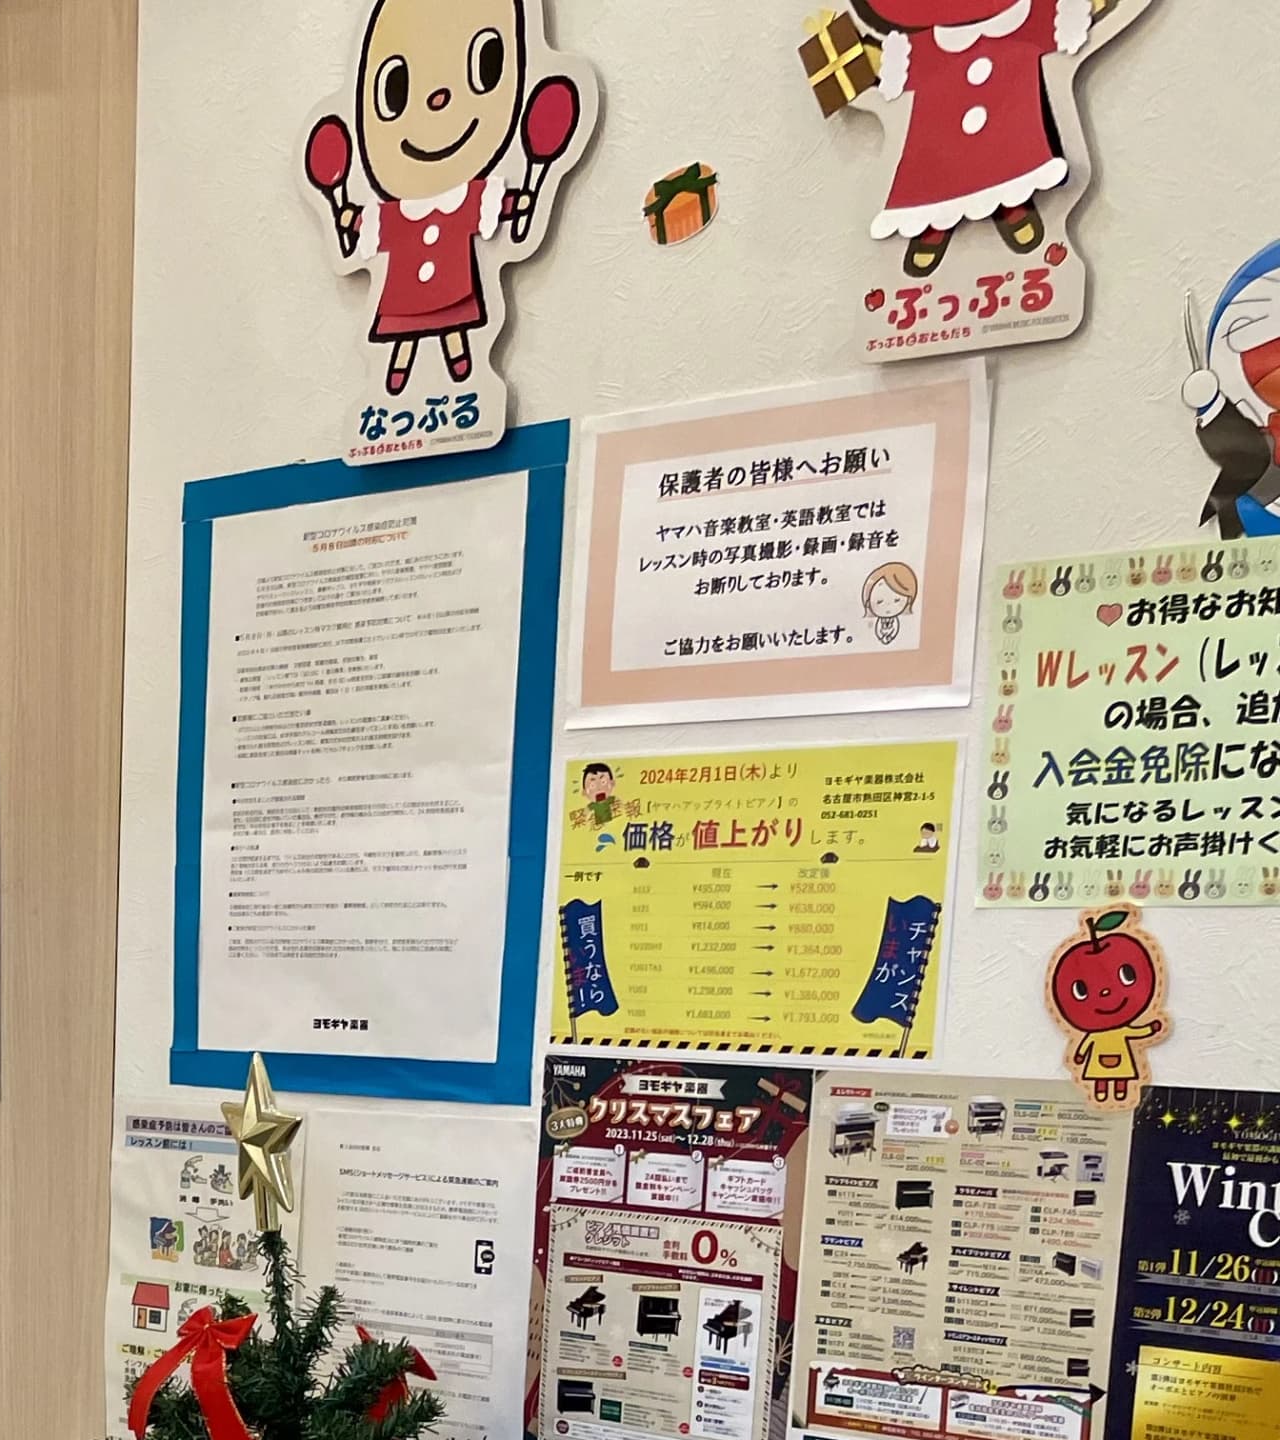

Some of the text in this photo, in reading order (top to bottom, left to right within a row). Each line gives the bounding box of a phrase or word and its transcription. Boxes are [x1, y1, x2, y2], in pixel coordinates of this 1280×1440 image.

[888, 267, 1054, 331] ぷっぷる
[658, 446, 891, 498] 保護者の皆様へお願い
[655, 499, 887, 542] ヤマハ音楽教室・英語教室では
[639, 529, 900, 573] レッスン時の写真撮影・録画・録音を
[694, 567, 829, 596] お断りしております。
[663, 625, 854, 657] ご協力をお願いいたします。
[1036, 641, 1180, 689] Wレッスン
[639, 762, 799, 786] 2024年2月1日(木)より
[820, 809, 879, 820] 052-681-0251
[564, 871, 603, 883] 一例です
[577, 914, 605, 1004] 買うなら
[552, 1064, 587, 1078] YAMAHA
[638, 1078, 709, 1095] ヨモギヤ楽器
[590, 1098, 762, 1133] クリスマスフェア
[690, 1229, 738, 1268] 0%
[1168, 1248, 1251, 1284] 11/26
[1163, 1295, 1246, 1331] 12/24
